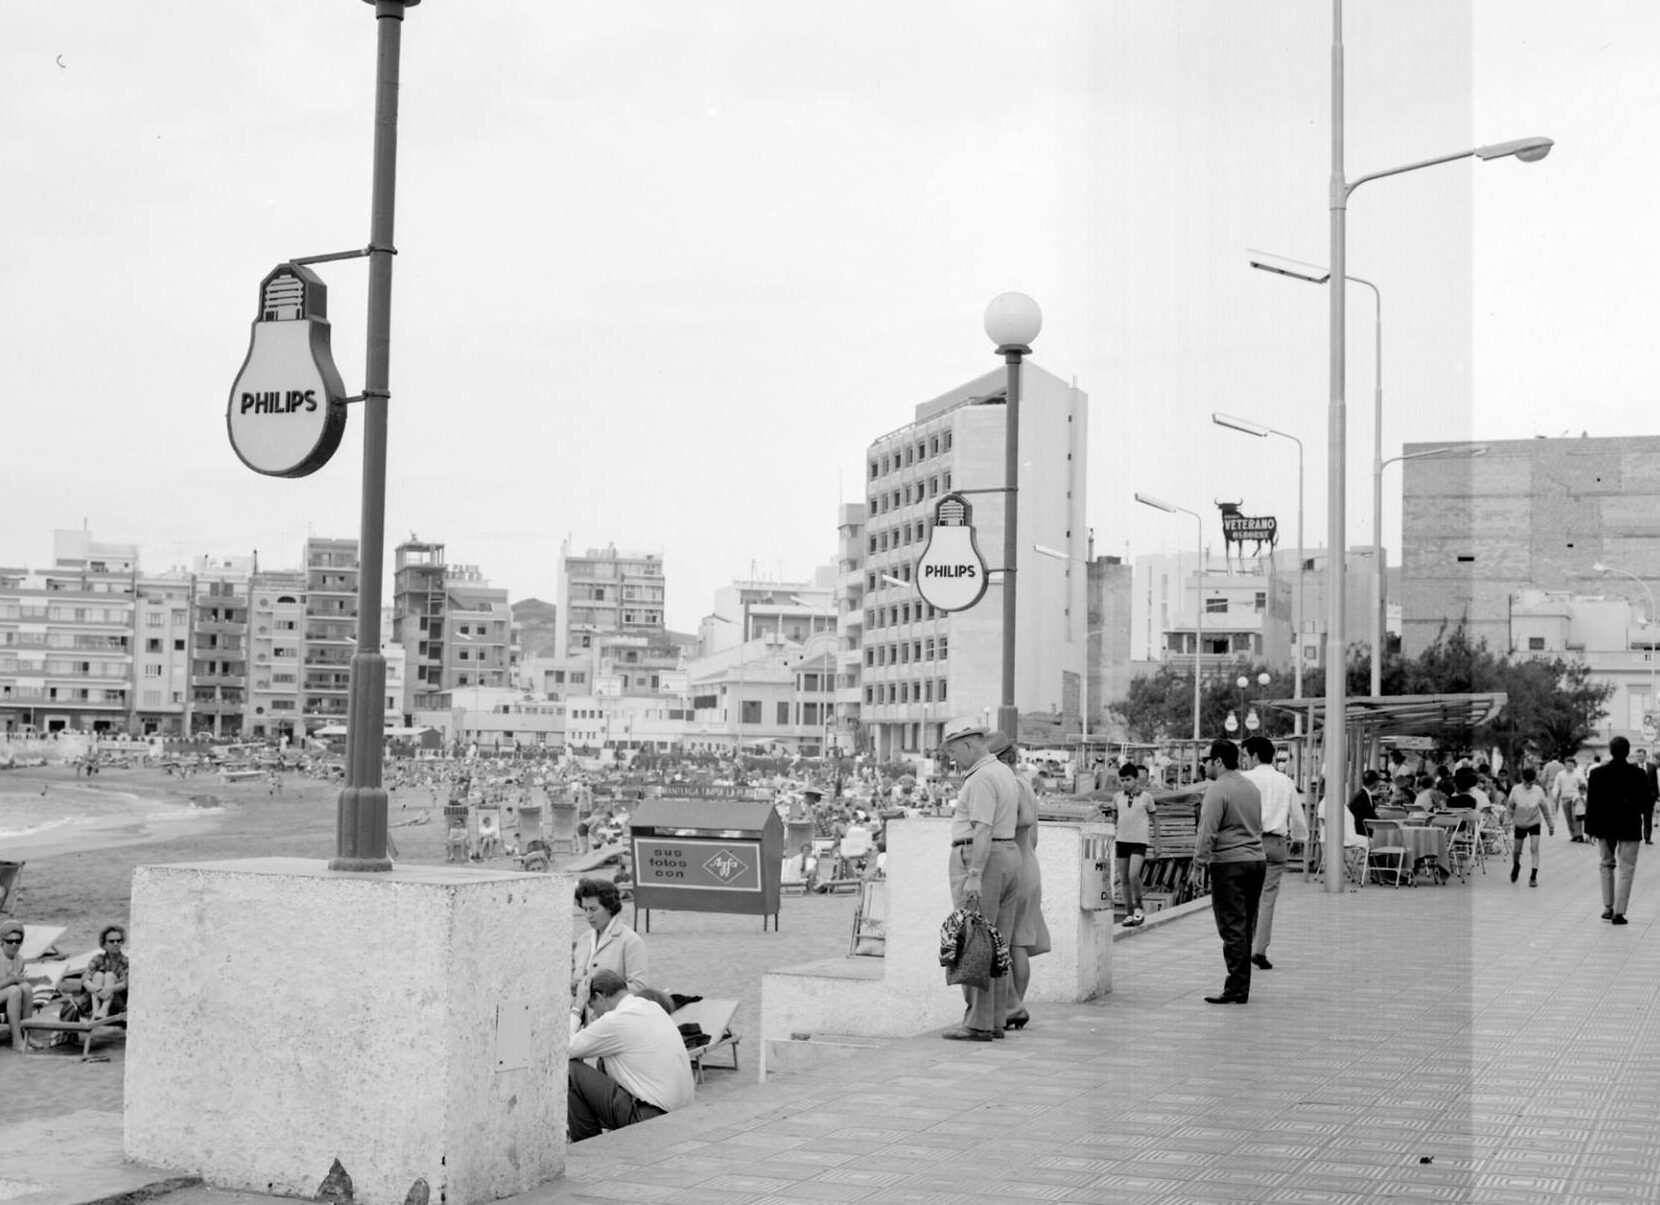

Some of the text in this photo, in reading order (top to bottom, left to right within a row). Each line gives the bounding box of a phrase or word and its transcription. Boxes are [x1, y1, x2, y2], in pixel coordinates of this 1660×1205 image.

[240, 388, 318, 415] PHILIPS
[1224, 519, 1275, 531] VETERANO
[925, 564, 976, 578] PHILIPS
[654, 849, 683, 858] sus
[649, 858, 688, 868] fotos
[709, 856, 739, 878] Agfa
[654, 869, 685, 878] con
